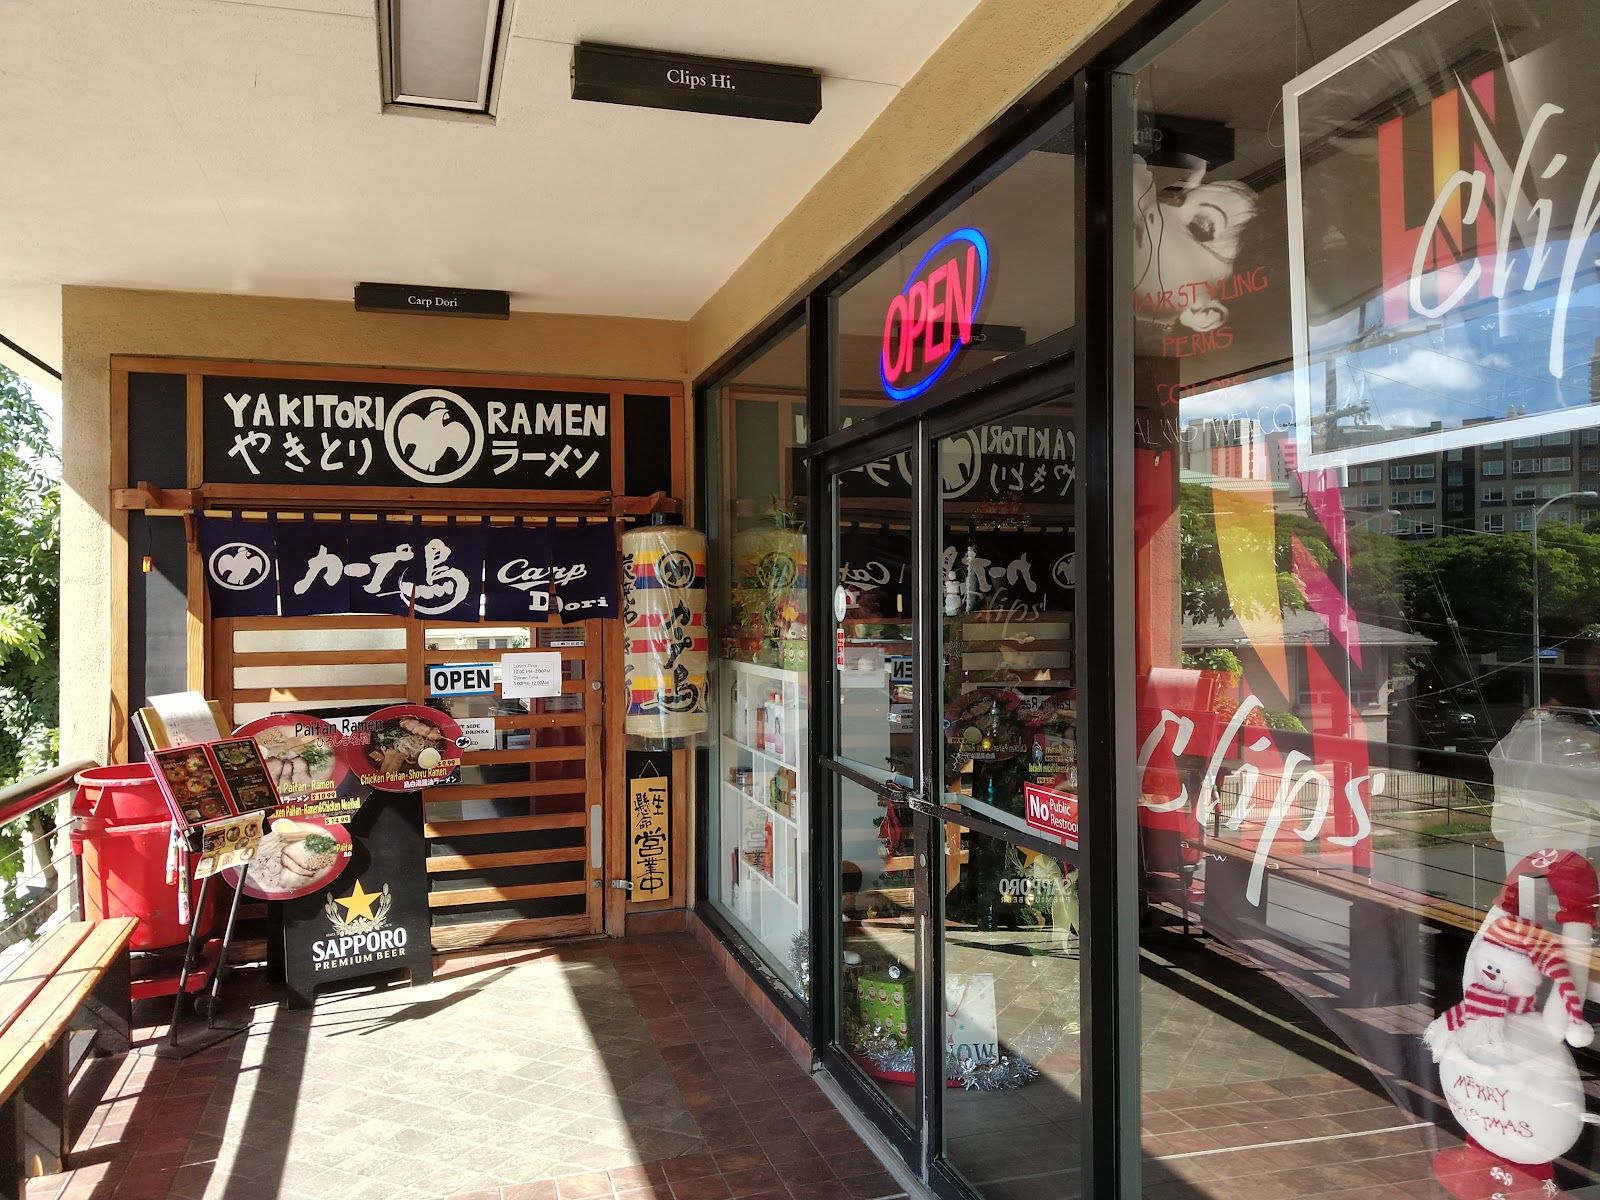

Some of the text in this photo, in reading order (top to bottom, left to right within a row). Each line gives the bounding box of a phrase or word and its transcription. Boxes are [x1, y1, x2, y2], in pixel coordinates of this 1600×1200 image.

[666, 69, 736, 90] Clips Hi.
[408, 296, 458, 308] Carp Dori
[882, 245, 976, 383] OPEN
[1161, 326, 1235, 358] PERMS
[224, 392, 606, 437] YAKITORI RAMEN
[227, 431, 600, 479] やきとり ラーメン
[293, 538, 471, 616] カープ鳥
[497, 558, 588, 591] Carp
[529, 591, 609, 613] Dori
[434, 669, 491, 691] OPEN
[295, 718, 384, 738] Paitan Ramen
[360, 774, 385, 785] Chicken
[428, 767, 447, 778] Ramen
[648, 787, 666, 816] 一生
[1029, 794, 1072, 822] No Public
[1136, 694, 1386, 908] Clips
[1050, 814, 1079, 834] Restroo
[634, 827, 667, 895] 営業中
[312, 927, 407, 962] SAPPORO
[314, 947, 406, 971] PREMIUM BEER
[1453, 1074, 1510, 1112] MERRY
